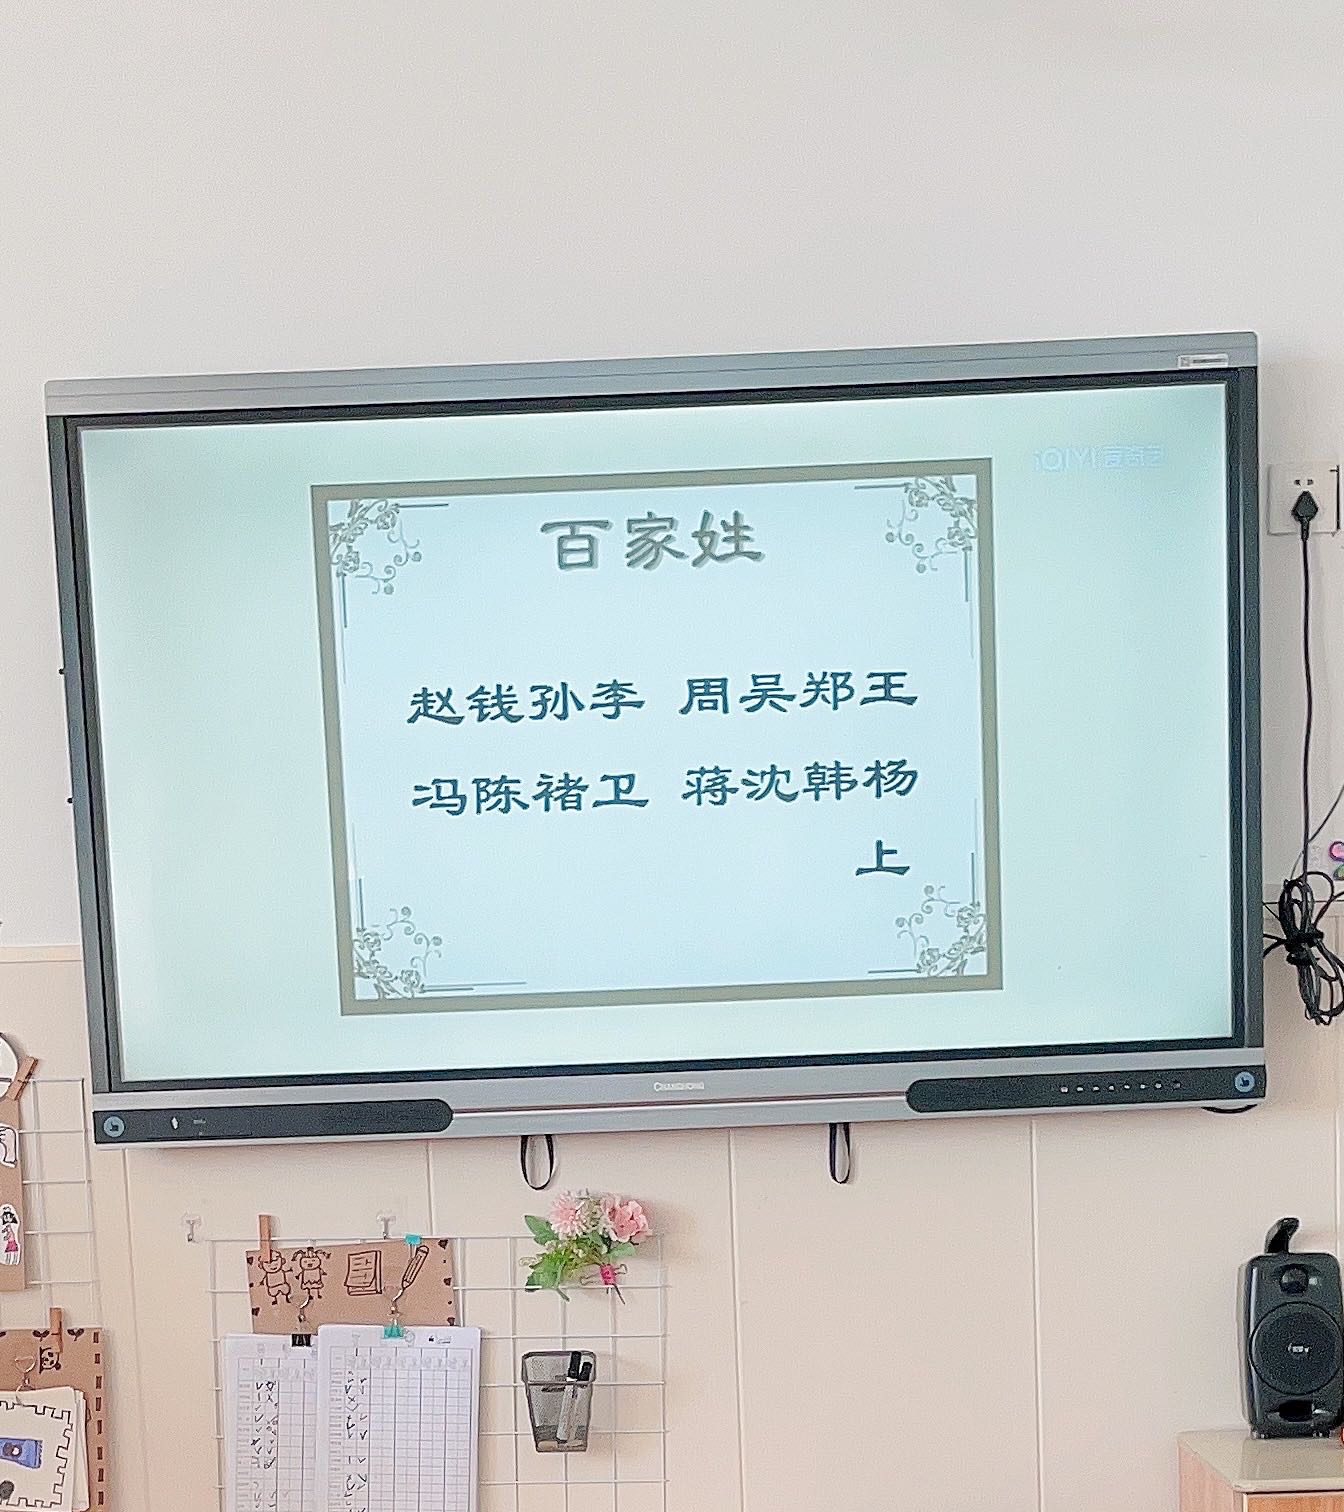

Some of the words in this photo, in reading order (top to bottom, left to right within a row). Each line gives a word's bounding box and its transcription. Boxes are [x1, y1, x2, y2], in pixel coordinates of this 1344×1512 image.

[540, 510, 766, 571] 百家姓
[407, 677, 646, 726] 赵钱孙李
[678, 670, 919, 716] 周吴郑王
[412, 771, 650, 816] 冯陈褚卫
[682, 759, 919, 807] 蒋沈韩杨
[855, 840, 912, 877] 上
